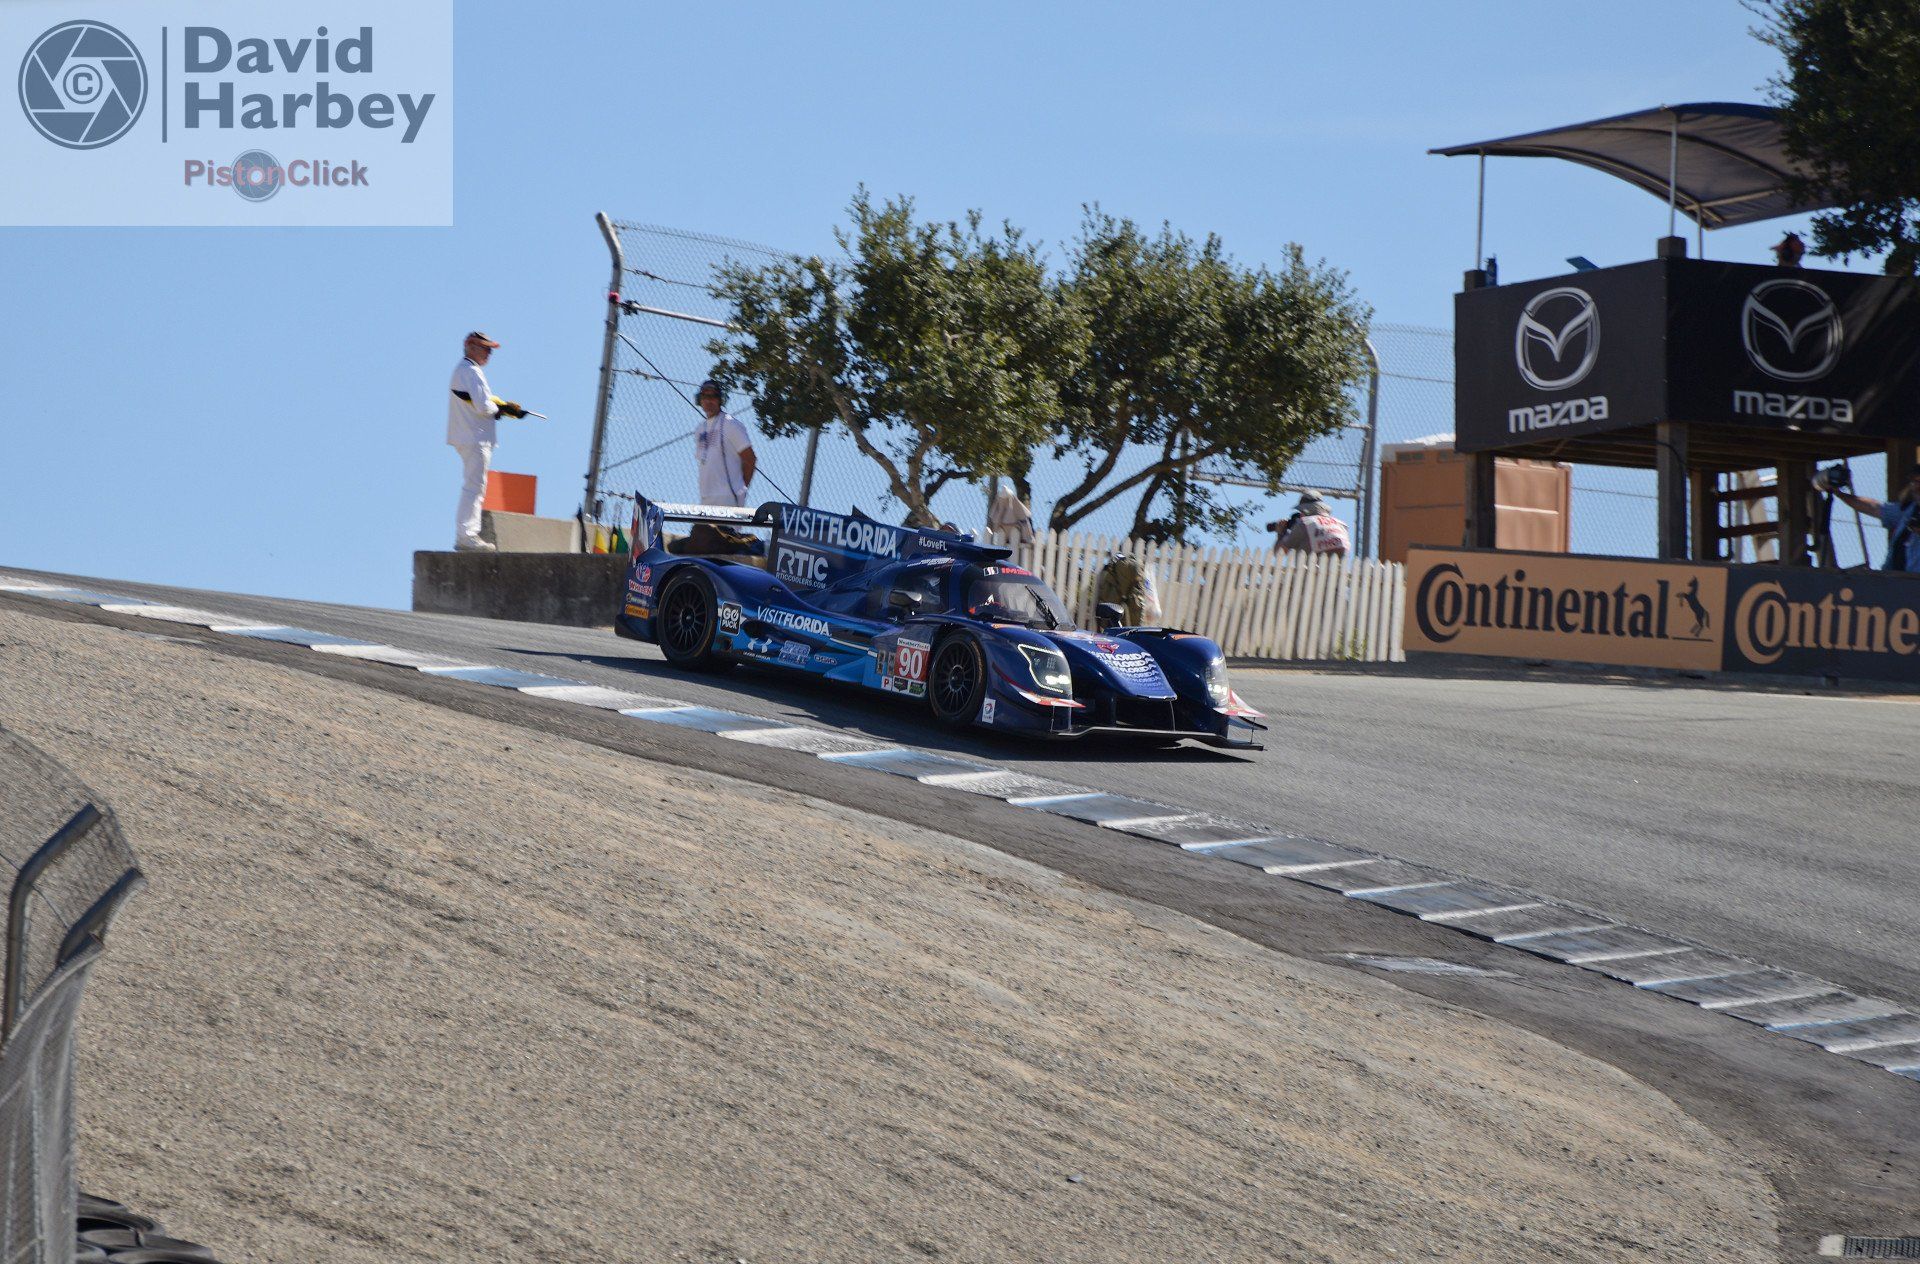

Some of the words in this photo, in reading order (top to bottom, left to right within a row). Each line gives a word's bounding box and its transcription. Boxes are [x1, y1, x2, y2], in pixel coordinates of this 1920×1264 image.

[1508, 395, 1609, 434] mazda
[1733, 390, 1854, 423] mazda
[919, 536, 948, 552] #LoveFL
[776, 547, 829, 582] RTIC
[722, 607, 739, 621] GO
[1416, 562, 1670, 643] Continental
[721, 619, 739, 630] PUCK
[898, 647, 923, 679] 90
[883, 678, 890, 688] P
